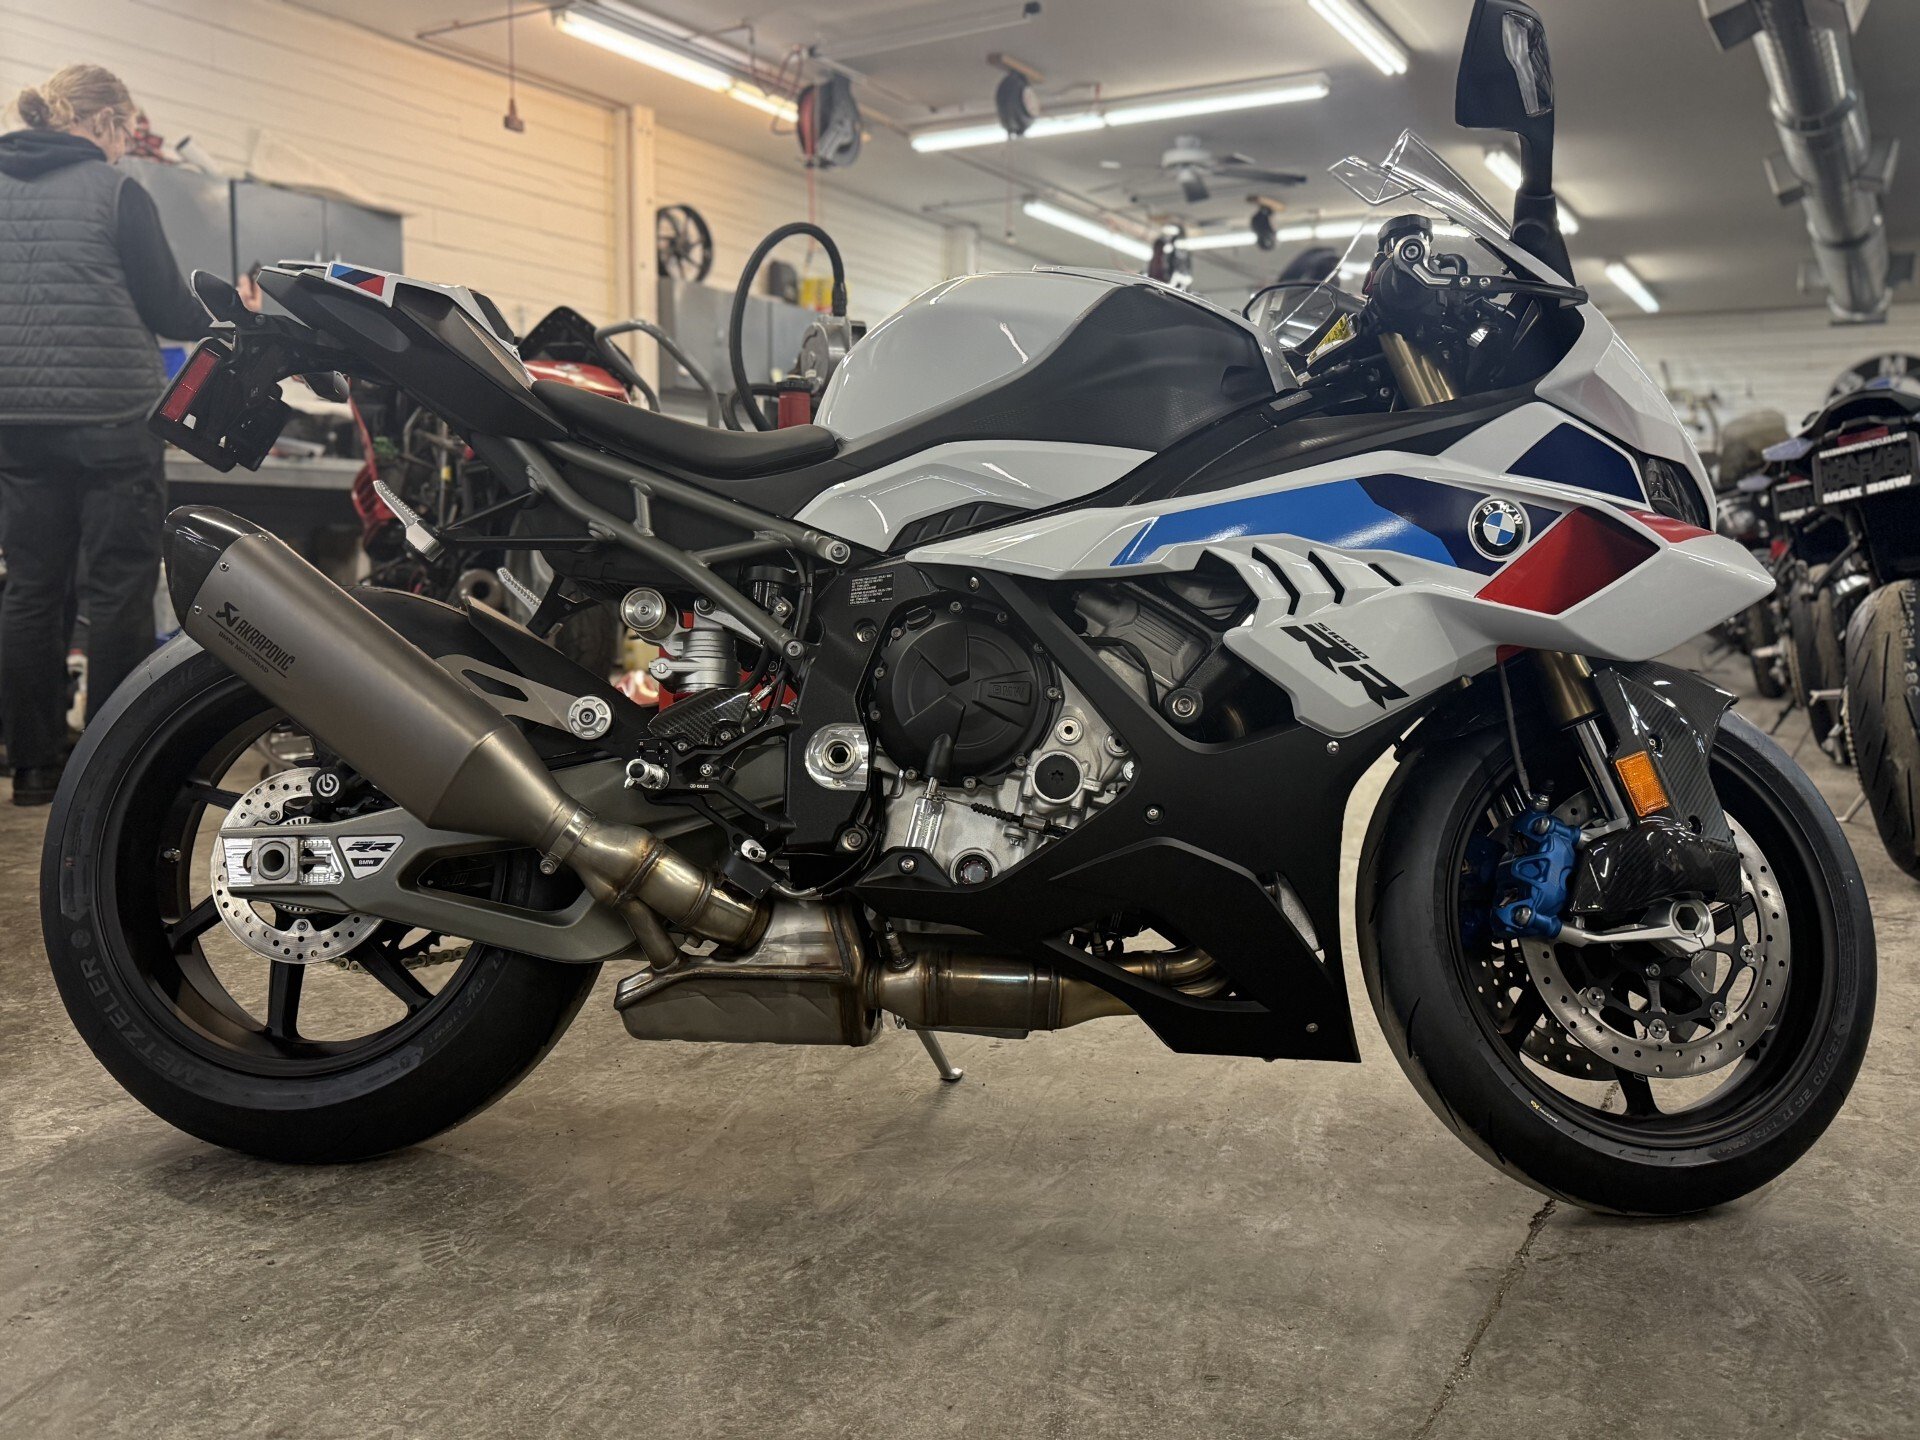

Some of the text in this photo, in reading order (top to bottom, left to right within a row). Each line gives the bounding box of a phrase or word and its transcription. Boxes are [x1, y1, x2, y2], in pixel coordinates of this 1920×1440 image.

[1822, 474, 1912, 504] MAX BMW
[1482, 501, 1524, 525] BMW
[218, 631, 269, 674] BMW MOTORRAD
[1280, 624, 1410, 710] RR
[992, 684, 1025, 698] BMW
[345, 842, 396, 852] RR
[79, 955, 198, 1084] METZELER
